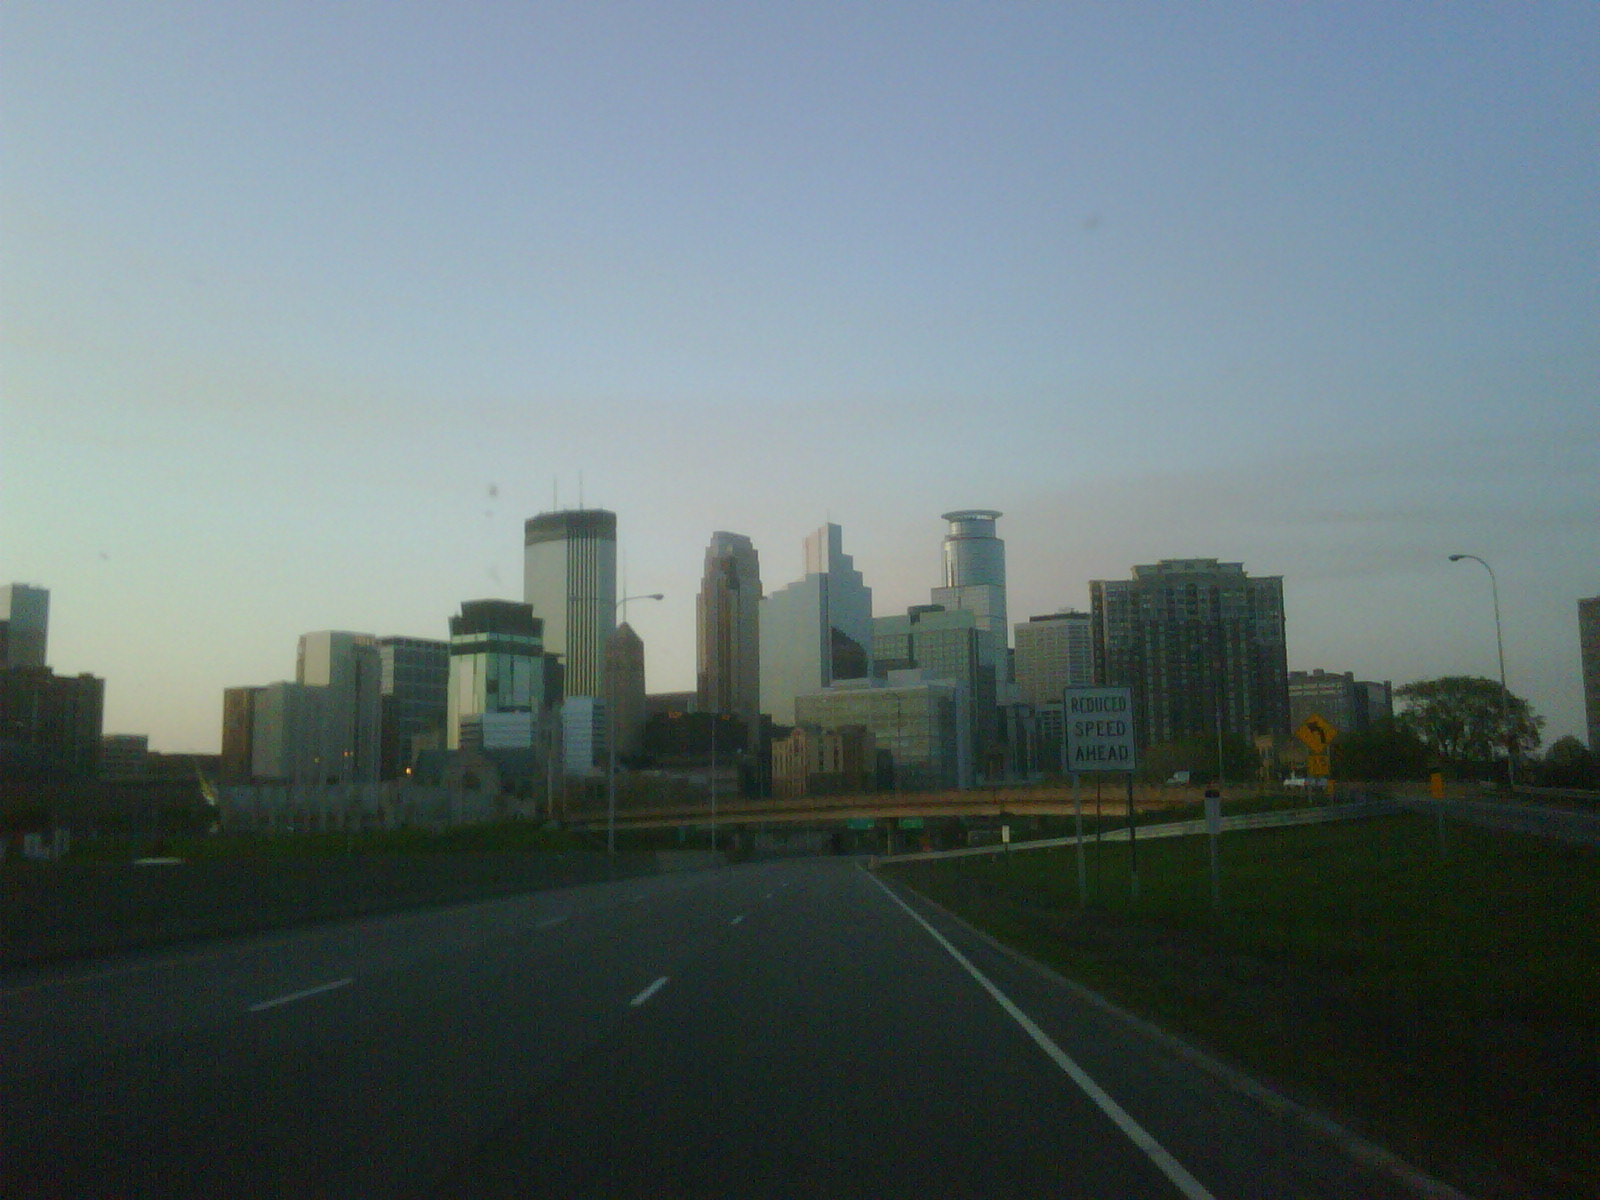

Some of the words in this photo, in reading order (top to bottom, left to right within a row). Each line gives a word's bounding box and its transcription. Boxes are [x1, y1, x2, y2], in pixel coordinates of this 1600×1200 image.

[1071, 696, 1127, 713] REDUCED
[1075, 720, 1126, 737] SPEED
[1076, 745, 1129, 762] AHEAD
